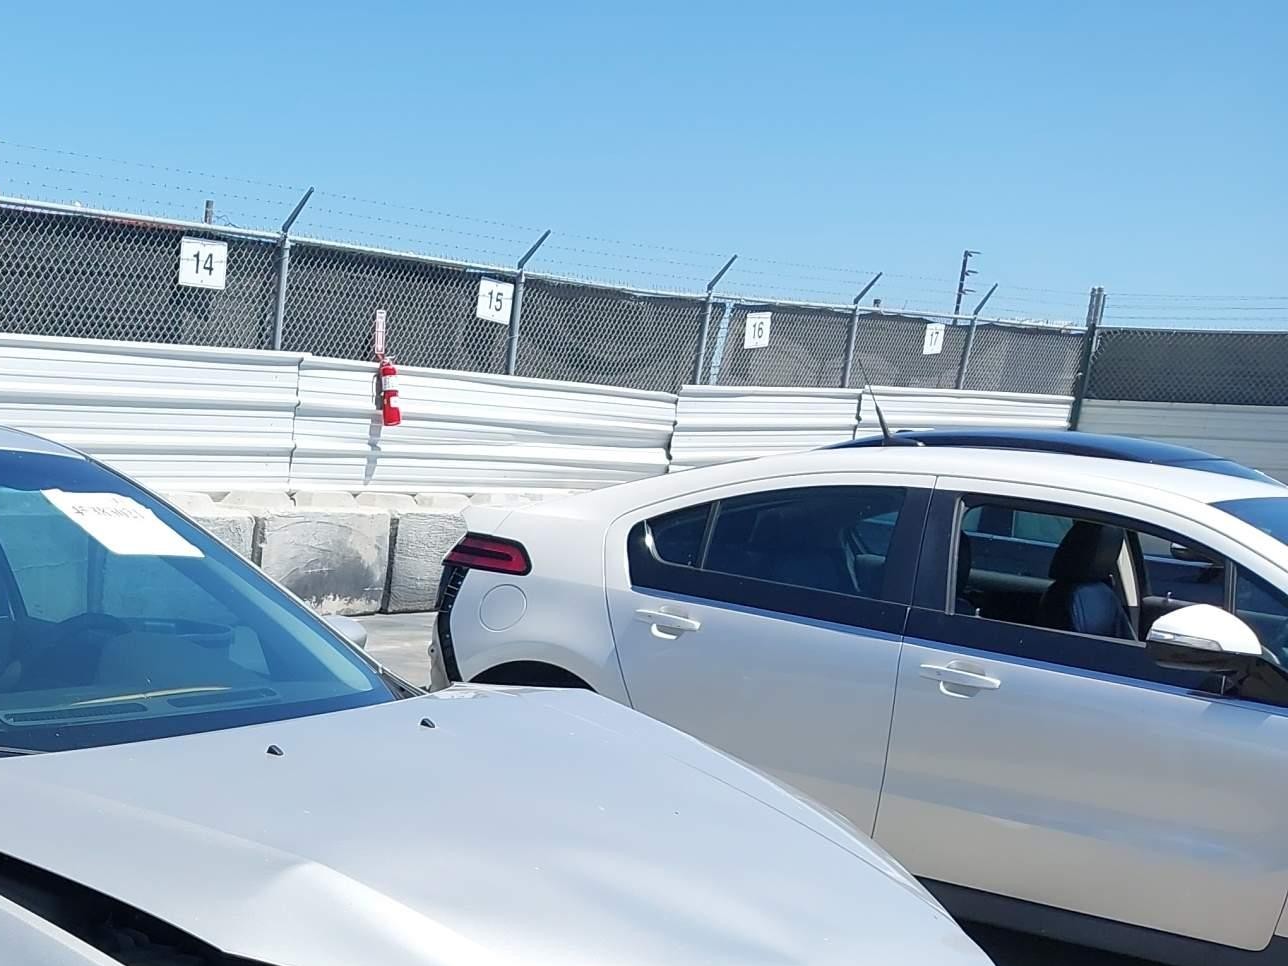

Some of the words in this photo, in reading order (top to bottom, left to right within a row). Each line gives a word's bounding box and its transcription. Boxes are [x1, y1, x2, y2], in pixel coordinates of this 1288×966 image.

[193, 251, 214, 276] 14
[487, 289, 505, 312] 15
[752, 321, 765, 340] 16
[929, 331, 940, 347] 17
